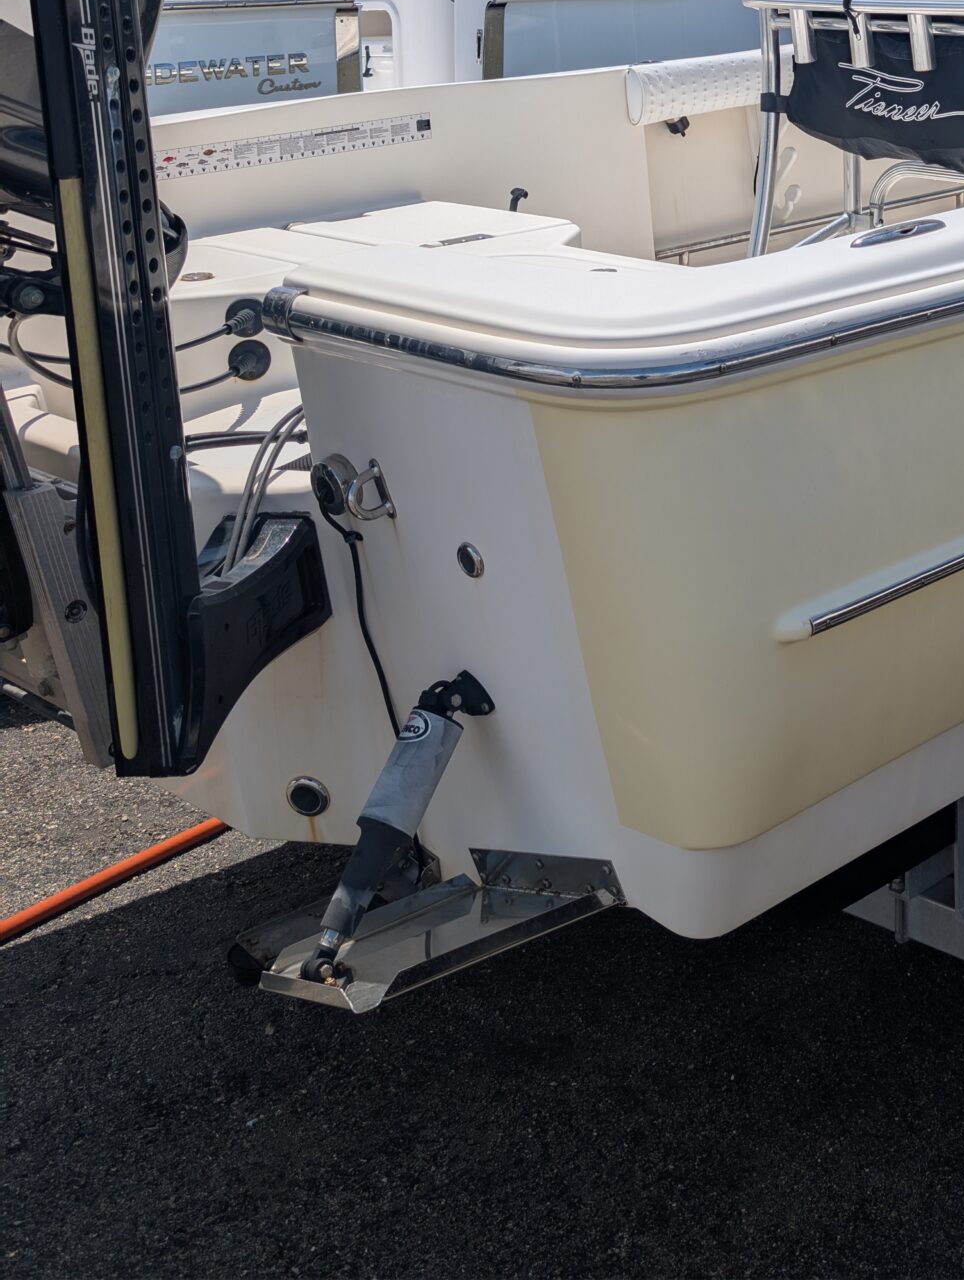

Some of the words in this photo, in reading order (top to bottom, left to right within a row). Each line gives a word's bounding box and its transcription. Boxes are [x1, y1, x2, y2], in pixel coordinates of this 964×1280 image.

[71, 27, 100, 96] Blade
[145, 52, 311, 86] IDEWATER
[257, 78, 323, 96] Custom
